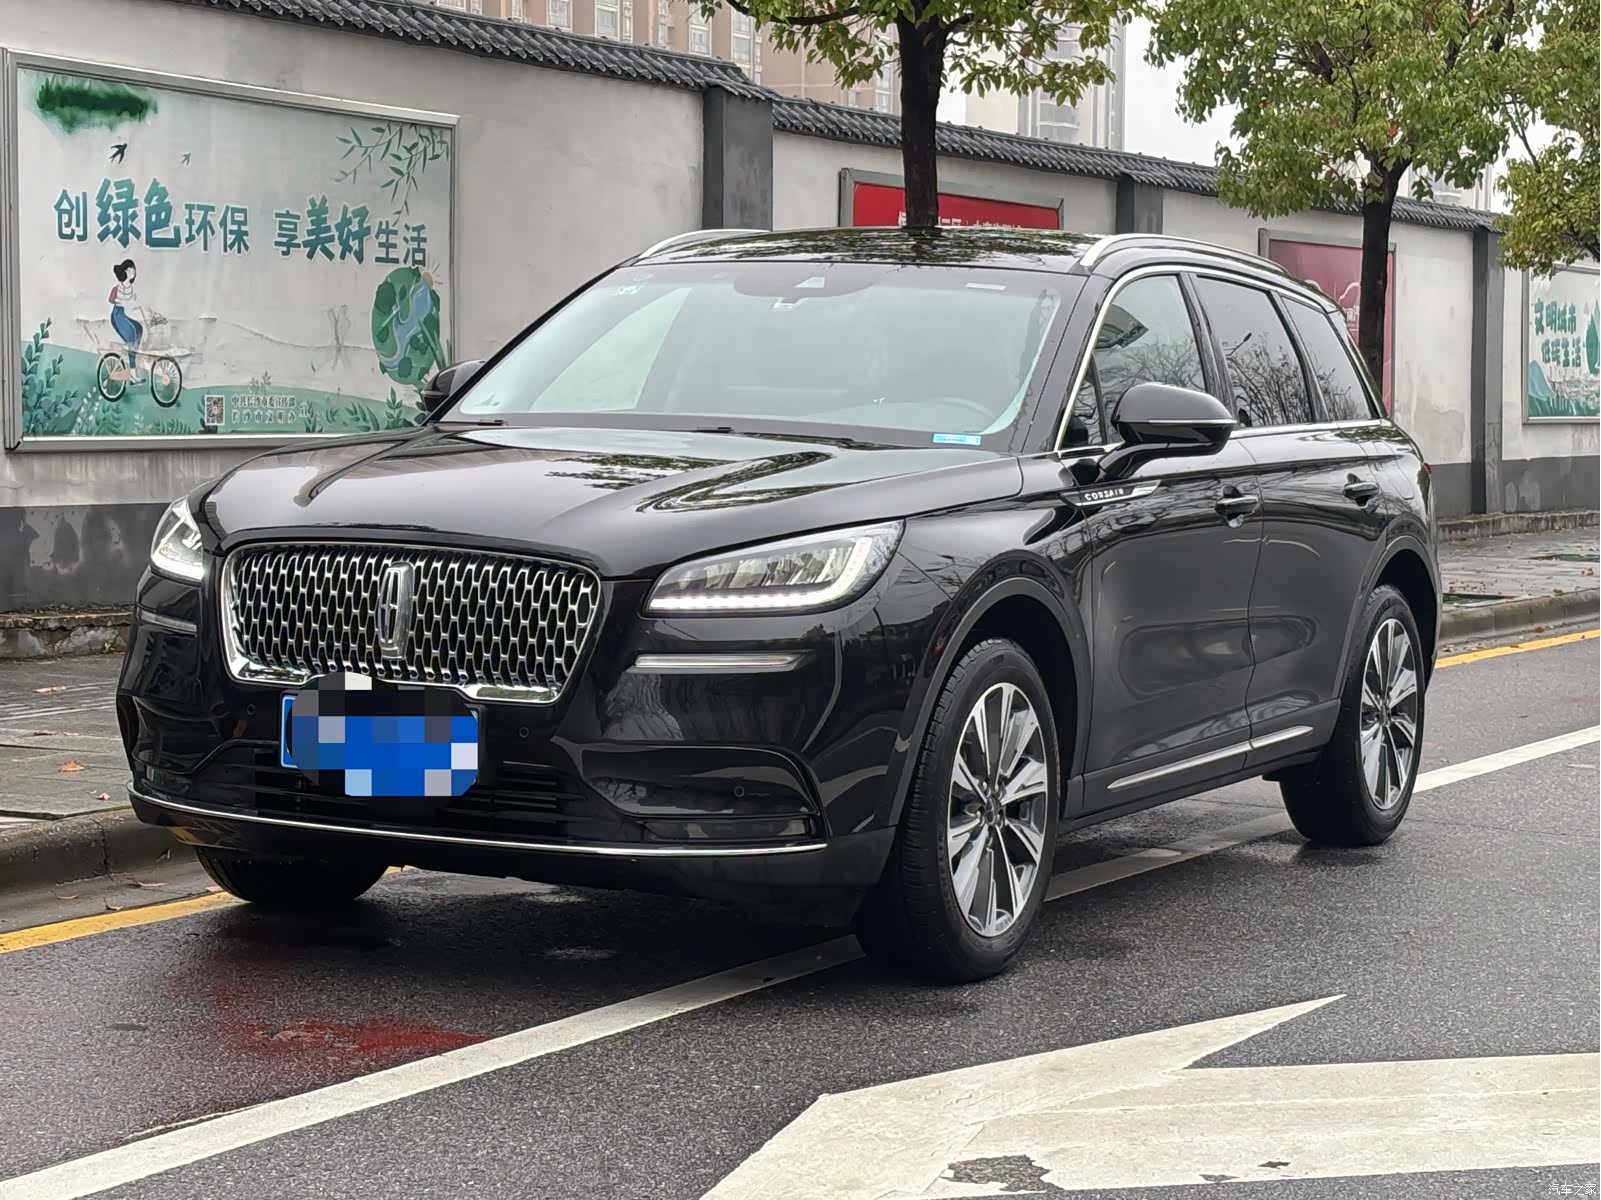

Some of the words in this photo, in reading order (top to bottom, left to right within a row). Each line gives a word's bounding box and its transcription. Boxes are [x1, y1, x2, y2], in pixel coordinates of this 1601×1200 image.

[54, 177, 250, 255] 创绿色环保
[274, 195, 429, 268] 享美好生活
[1534, 298, 1577, 336] 文明城市
[1541, 336, 1581, 368] 低碳生活
[1084, 487, 1124, 501] CORSAIR
